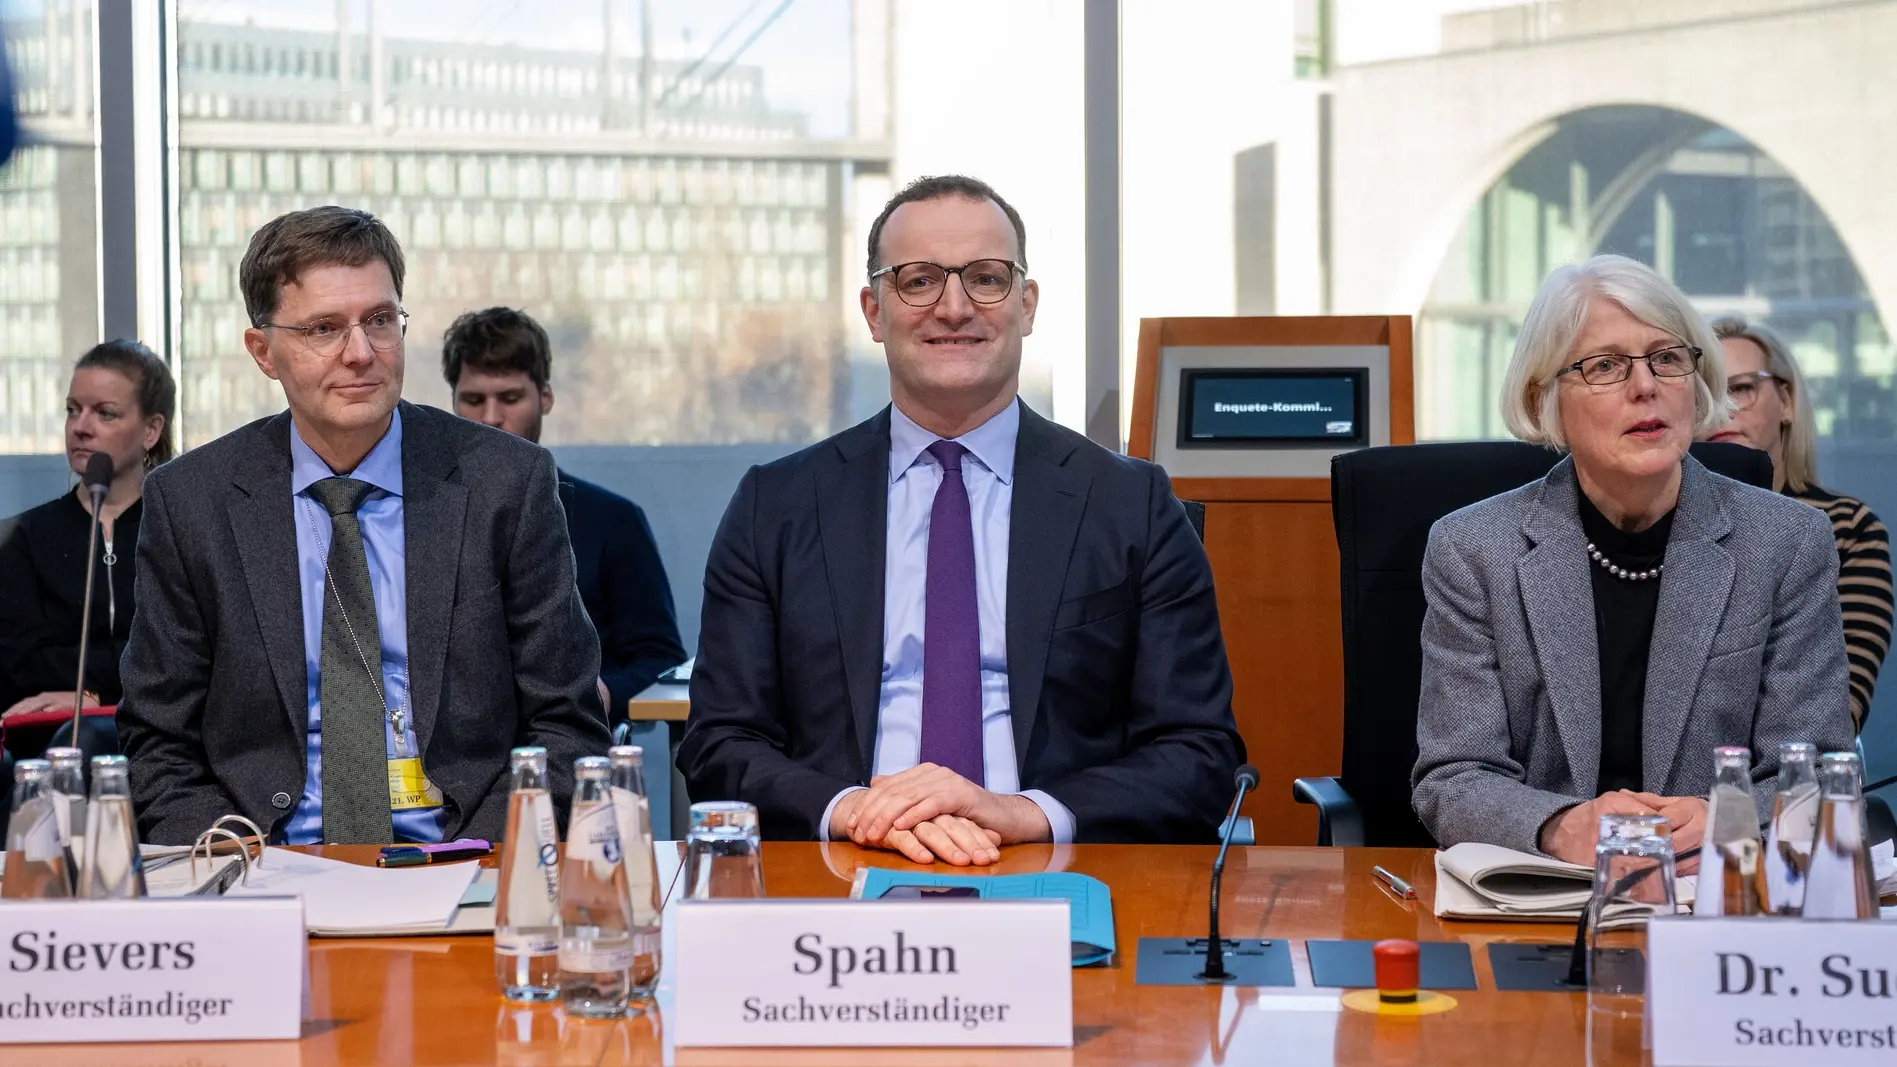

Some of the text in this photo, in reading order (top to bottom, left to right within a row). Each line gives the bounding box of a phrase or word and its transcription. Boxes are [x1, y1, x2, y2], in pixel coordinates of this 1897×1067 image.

[1214, 401, 1333, 414] Enquete-Kommi...
[391, 795, 421, 805] 21. WP
[9, 930, 195, 972] Sievers
[793, 931, 958, 988] Spahn
[1715, 953, 1897, 998] Dr. Su
[743, 996, 1010, 1030] Sachverständiger
[1735, 1018, 1897, 1049] Sachverst
